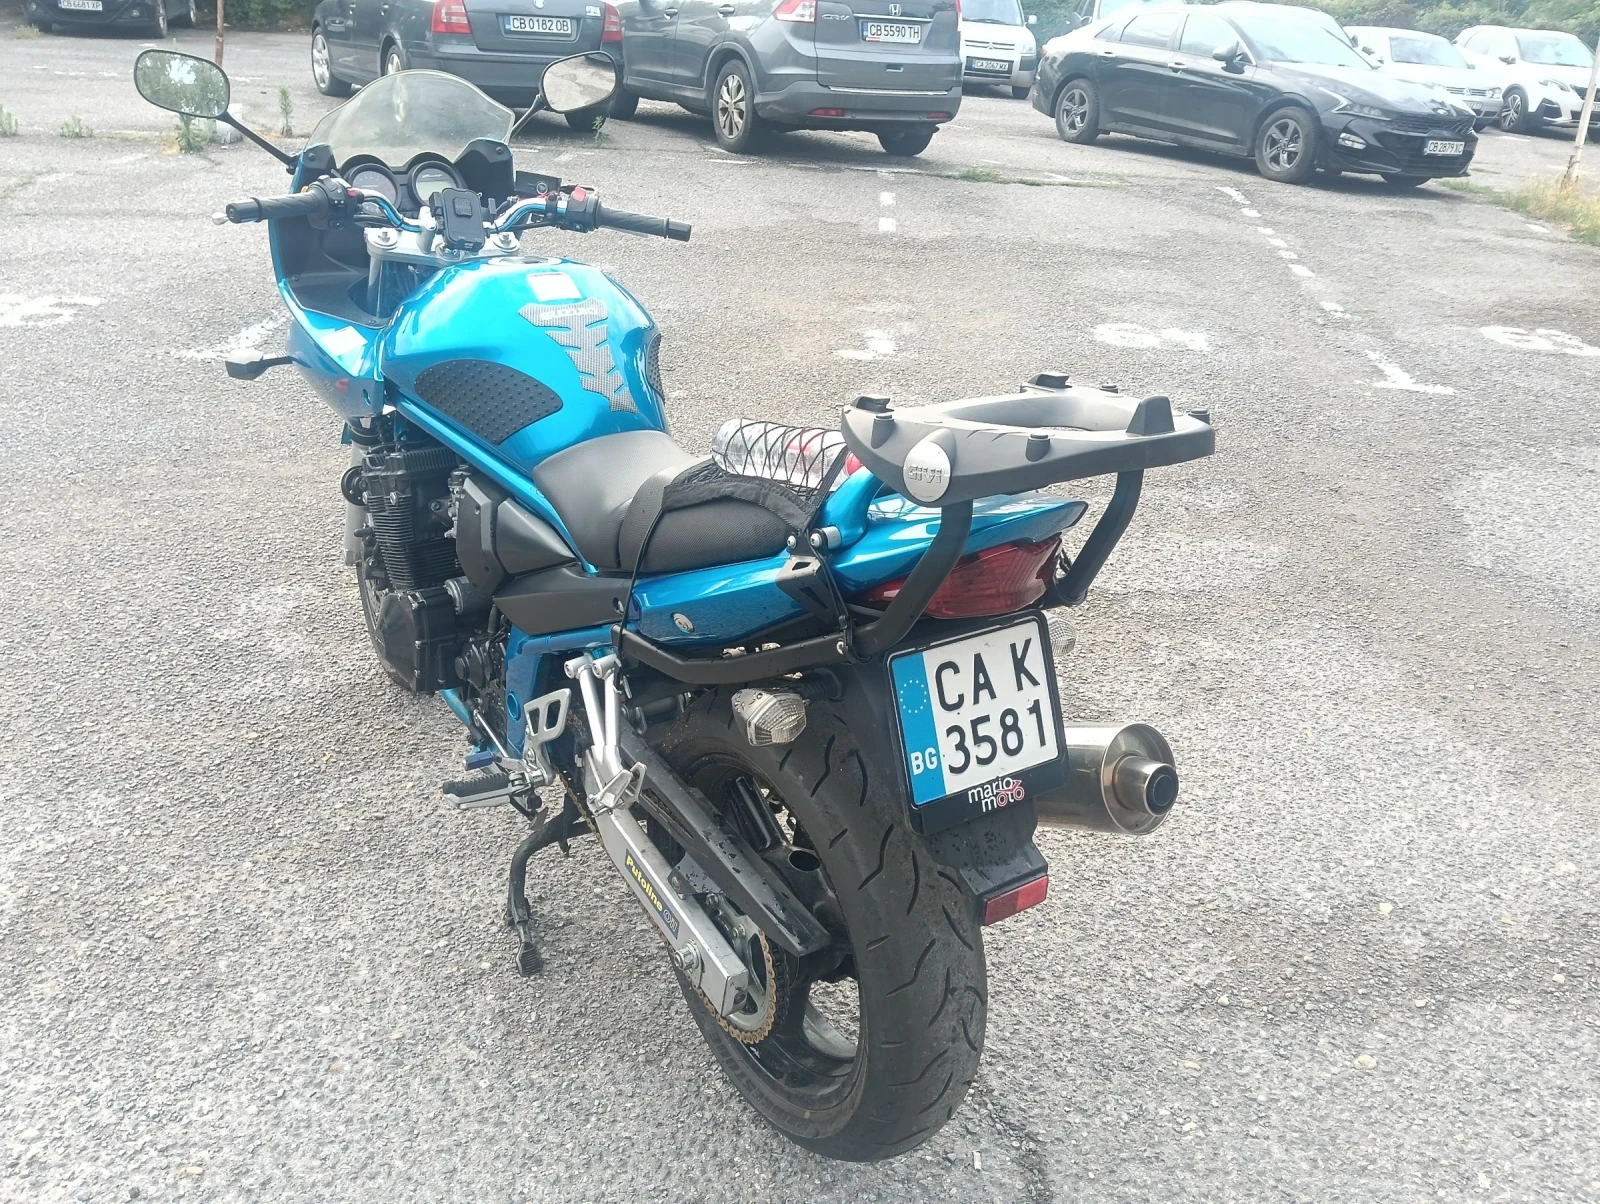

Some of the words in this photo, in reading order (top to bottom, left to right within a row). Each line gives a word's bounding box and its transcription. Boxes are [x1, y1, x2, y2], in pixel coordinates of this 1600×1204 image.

[512, 17, 527, 29] CB
[528, 18, 554, 31] 0182
[869, 24, 882, 36] CB
[883, 25, 906, 38] 5590
[907, 26, 920, 39] TH
[1428, 141, 1438, 152] CB
[1439, 142, 1455, 153] 2879
[907, 465, 944, 484] GIVI
[935, 652, 997, 712] CA
[1009, 638, 1041, 692] K
[945, 699, 1047, 775] 3581
[910, 747, 938, 776] BG
[968, 777, 1014, 804] mario
[981, 788, 1026, 813] moto
[626, 854, 663, 912] Putoline
